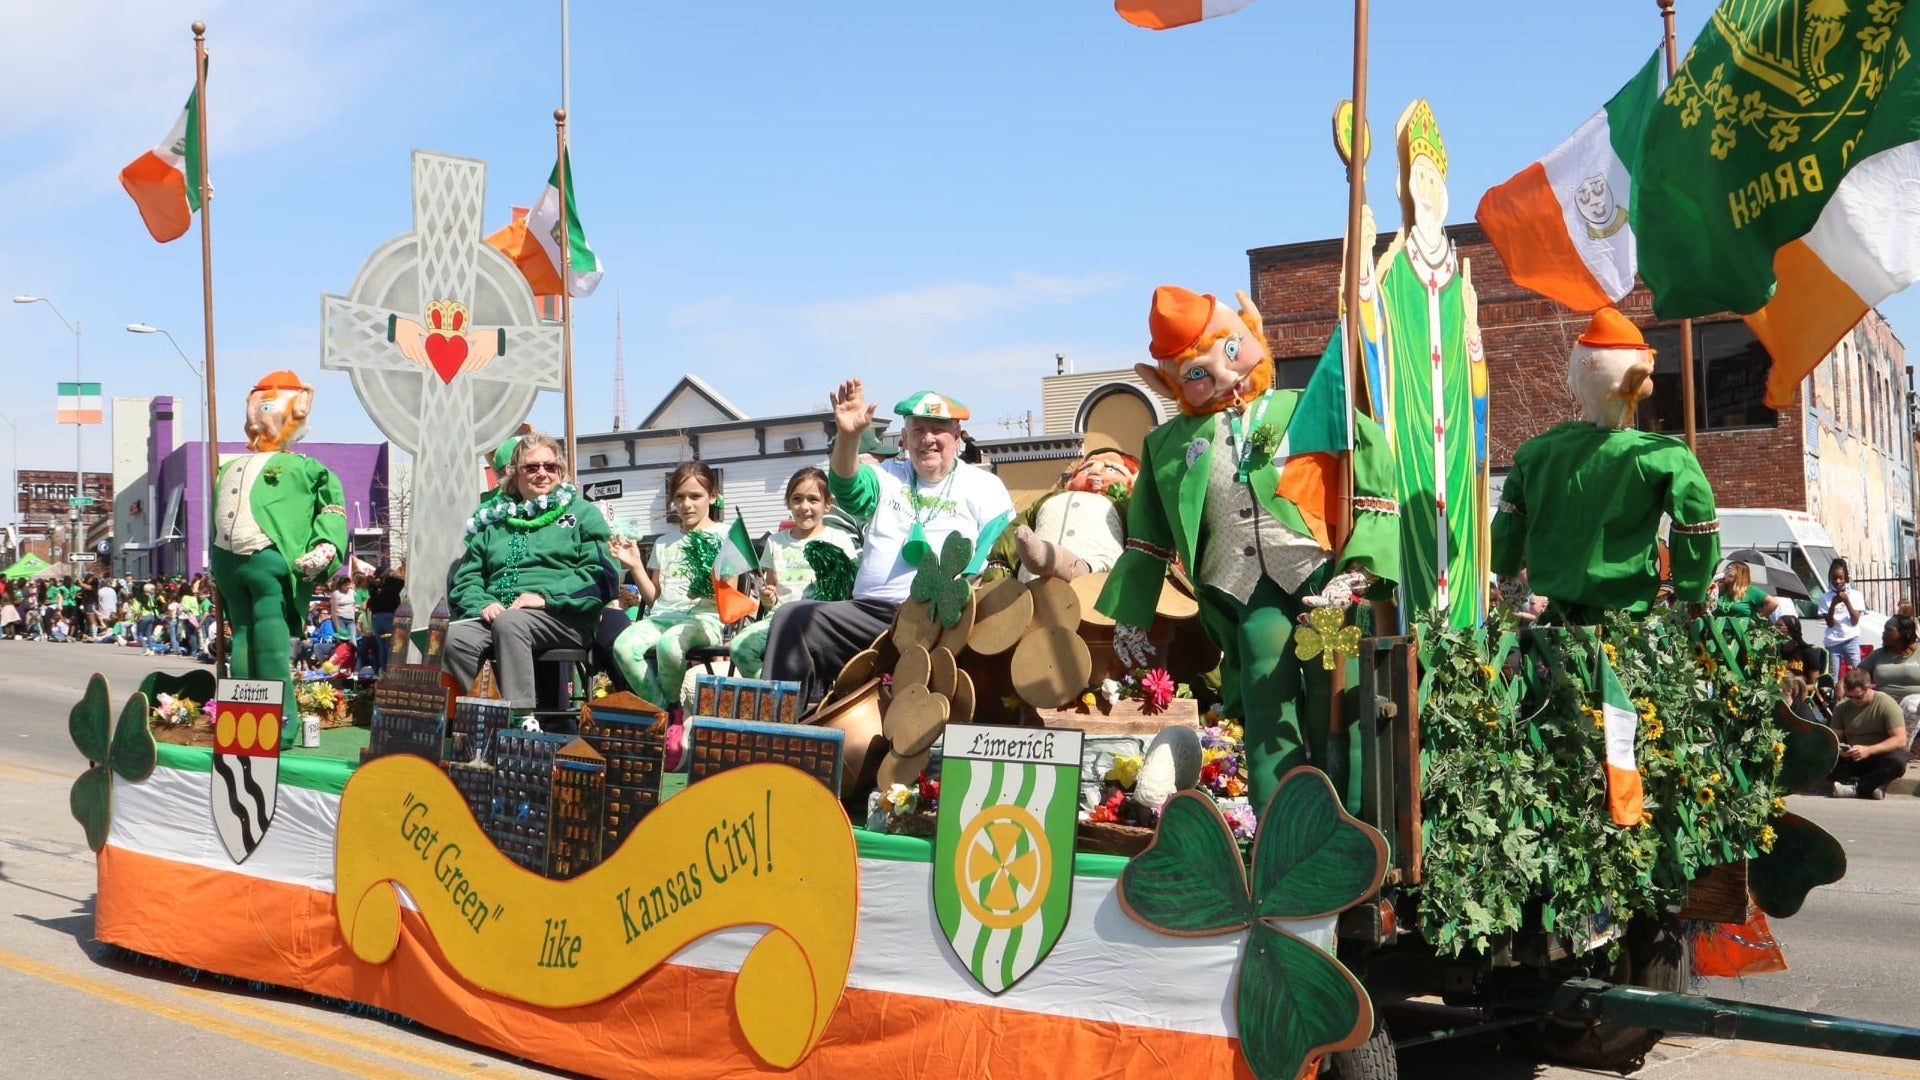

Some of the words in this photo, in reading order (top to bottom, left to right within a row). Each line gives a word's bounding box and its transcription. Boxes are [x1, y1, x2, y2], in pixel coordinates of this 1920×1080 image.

[594, 487, 606, 496] ONE
[607, 485, 618, 495] WAY
[231, 683, 268, 701] Leitrim
[967, 732, 1055, 759] Limerick
[401, 792, 439, 861] "Get
[434, 843, 504, 934] Green"
[537, 918, 582, 968] like
[616, 863, 702, 945] Kansas
[705, 789, 773, 884] City!
